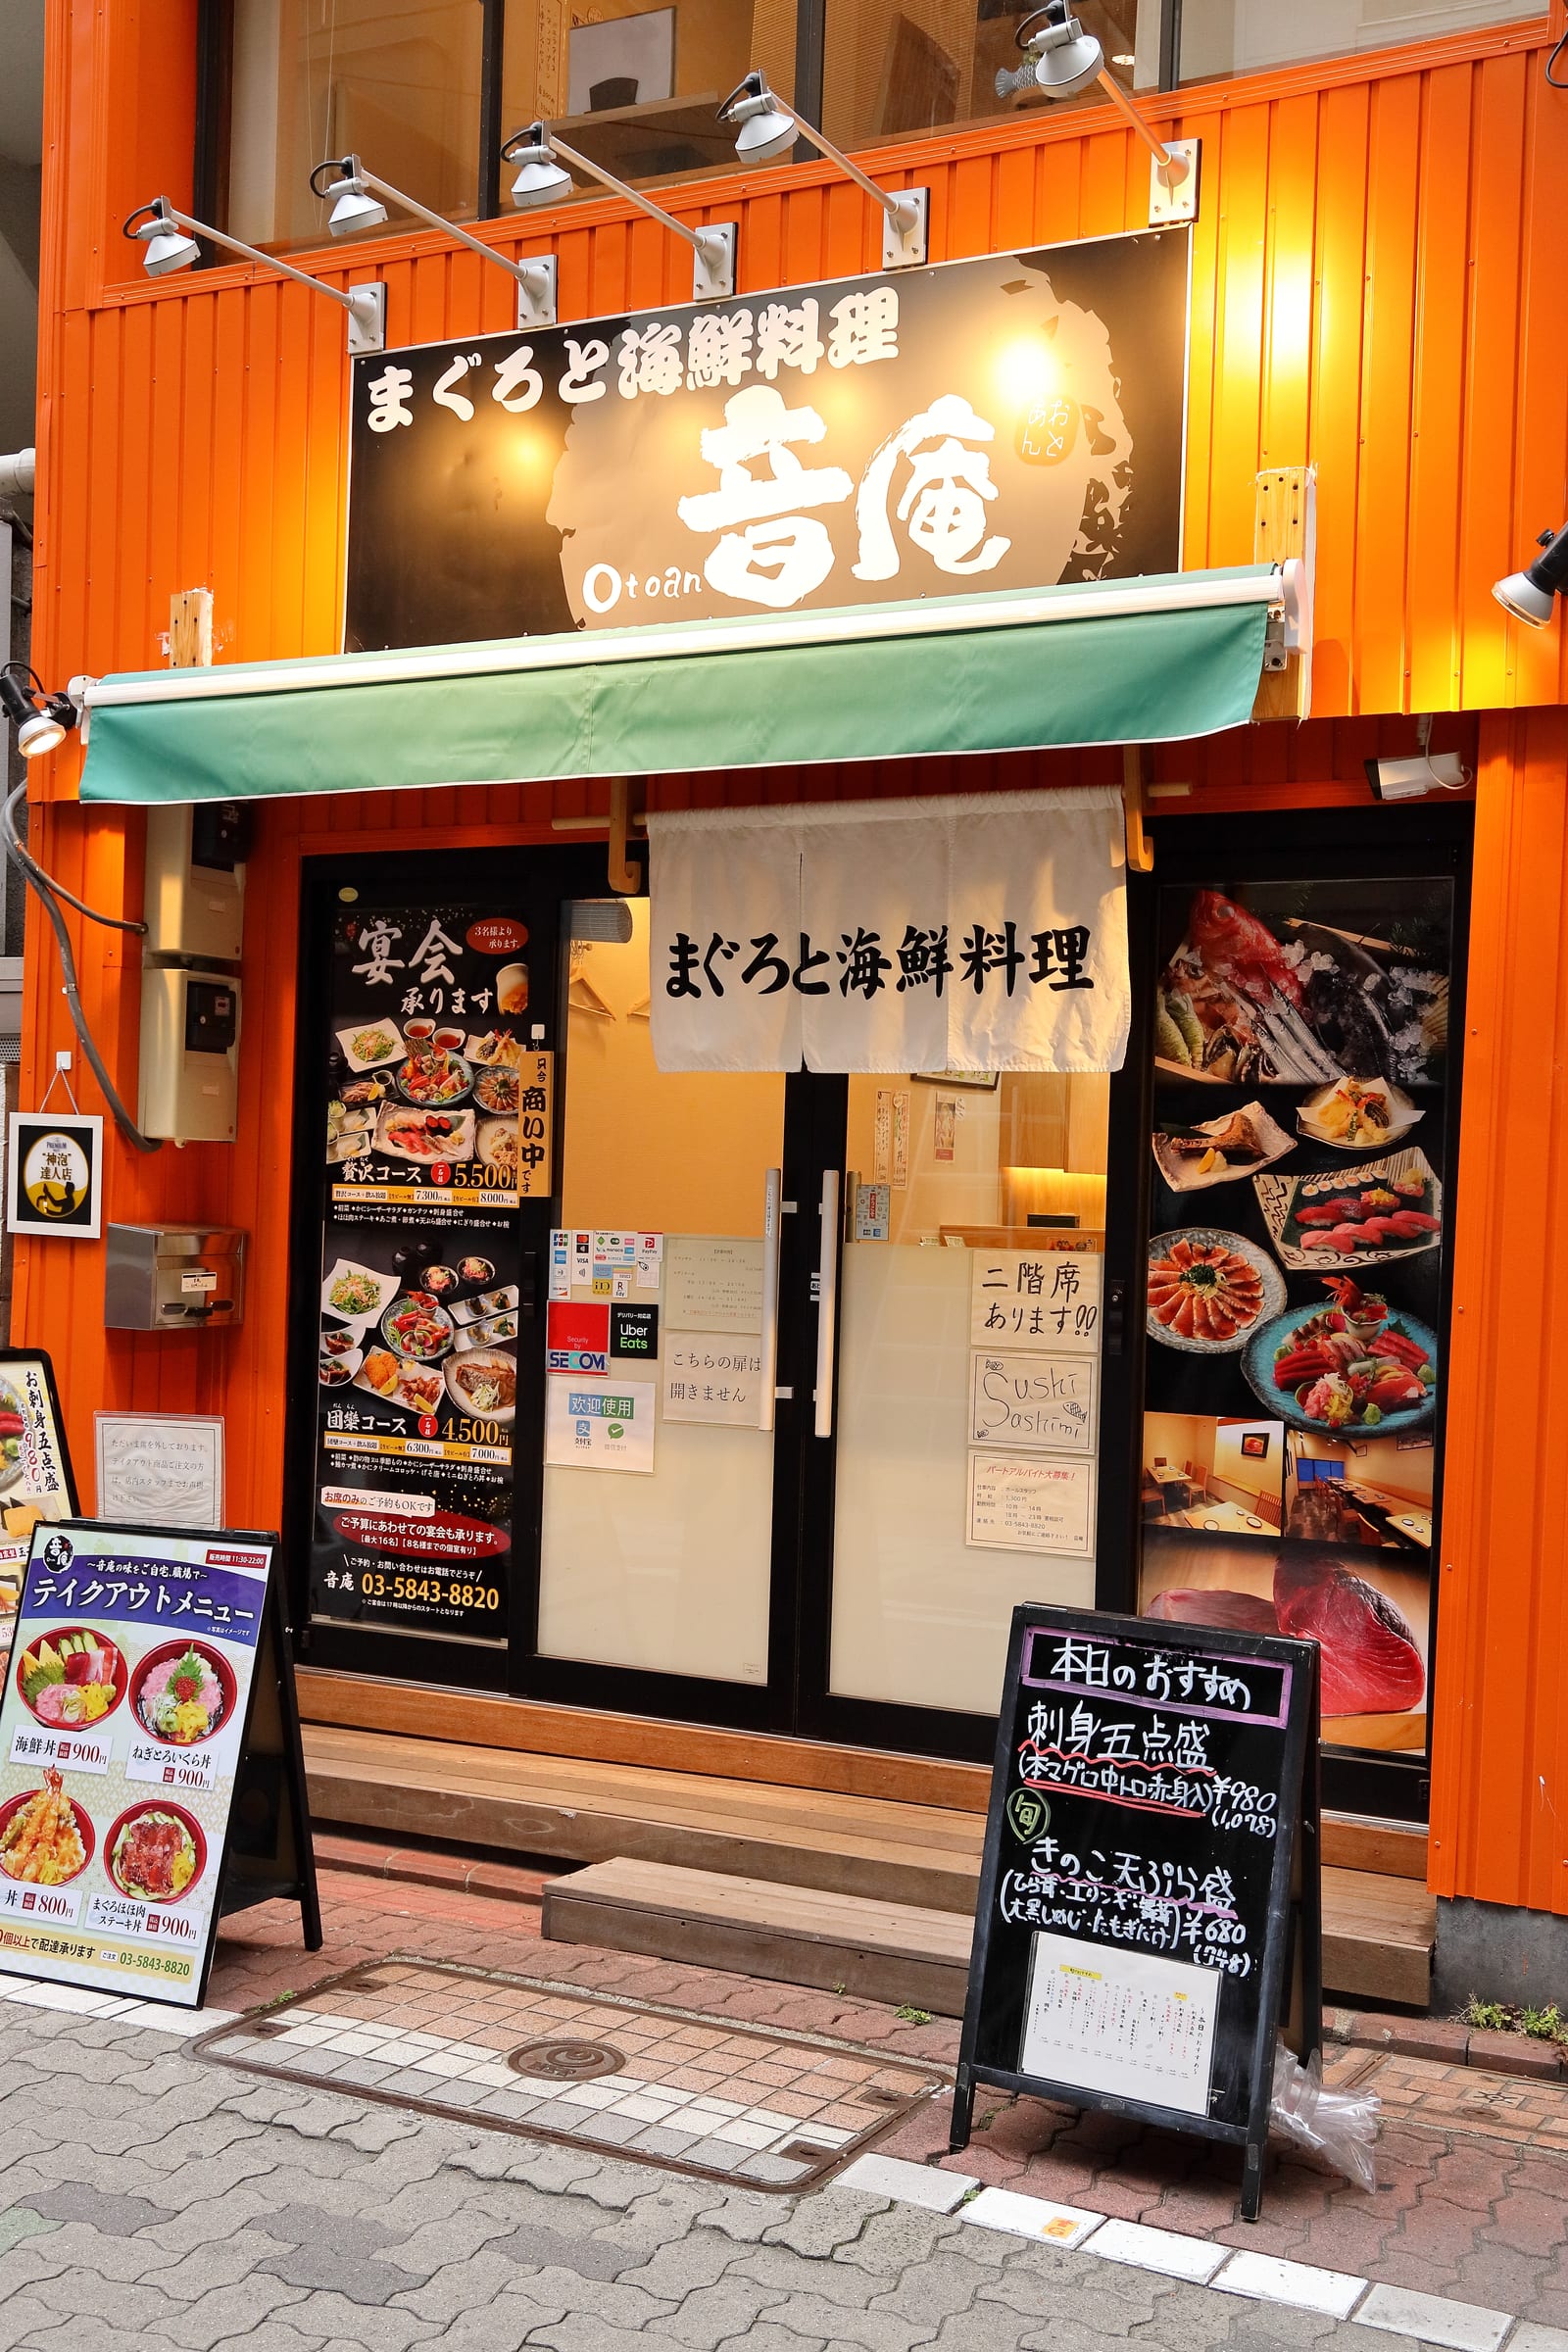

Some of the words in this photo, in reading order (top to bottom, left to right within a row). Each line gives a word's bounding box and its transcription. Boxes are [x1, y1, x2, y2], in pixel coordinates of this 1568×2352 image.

[366, 285, 900, 434] まぐろと海鮮料理
[676, 384, 1012, 609] 音庵
[581, 560, 703, 613] Otoan
[474, 925, 513, 938] 3名様より
[351, 918, 464, 986] 宴会
[666, 920, 1095, 1001] まぐろと海鮮料理
[400, 986, 494, 1015] 承ります
[40, 1166, 73, 1181] 達人店
[982, 1261, 1081, 1303] 二階席
[619, 1337, 648, 1349] Eats
[620, 1324, 648, 1336] Uber
[550, 1351, 605, 1370] SECOM
[673, 1352, 761, 1373] こちらの扉は
[571, 1396, 632, 1417] 欢迎使用
[670, 1382, 746, 1403] 開きません
[25, 1369, 60, 1493] お刺身五点盛
[324, 1491, 433, 1512] お席のみのご予約もOKです
[340, 1516, 499, 1545] ご予算にあわせての宴会も承ります。
[231, 1555, 265, 1565] 11:30-22:00
[32, 1578, 255, 1624] テイクアウトメニュー
[322, 1569, 355, 1592] 音庵
[361, 1572, 500, 1610] 03-5843-8820
[1050, 1637, 1251, 1711] 本日のおすすめ
[15, 1736, 57, 1756] 海鮮丼
[73, 1742, 108, 1765] 900円
[1027, 1700, 1216, 1773] 刺身五点盛
[131, 1744, 212, 1770] ねぎとろいくら丼
[178, 1767, 211, 1789] 900円
[1030, 1836, 1237, 1911] きのこ天ぷら盛
[37, 1893, 74, 1919] 800円
[92, 1897, 146, 1918] まぐろほほ肉
[162, 1914, 197, 1940] 900円
[98, 1915, 142, 1934] ステーキ丼
[120, 1951, 190, 1977] 03-5843-8820
